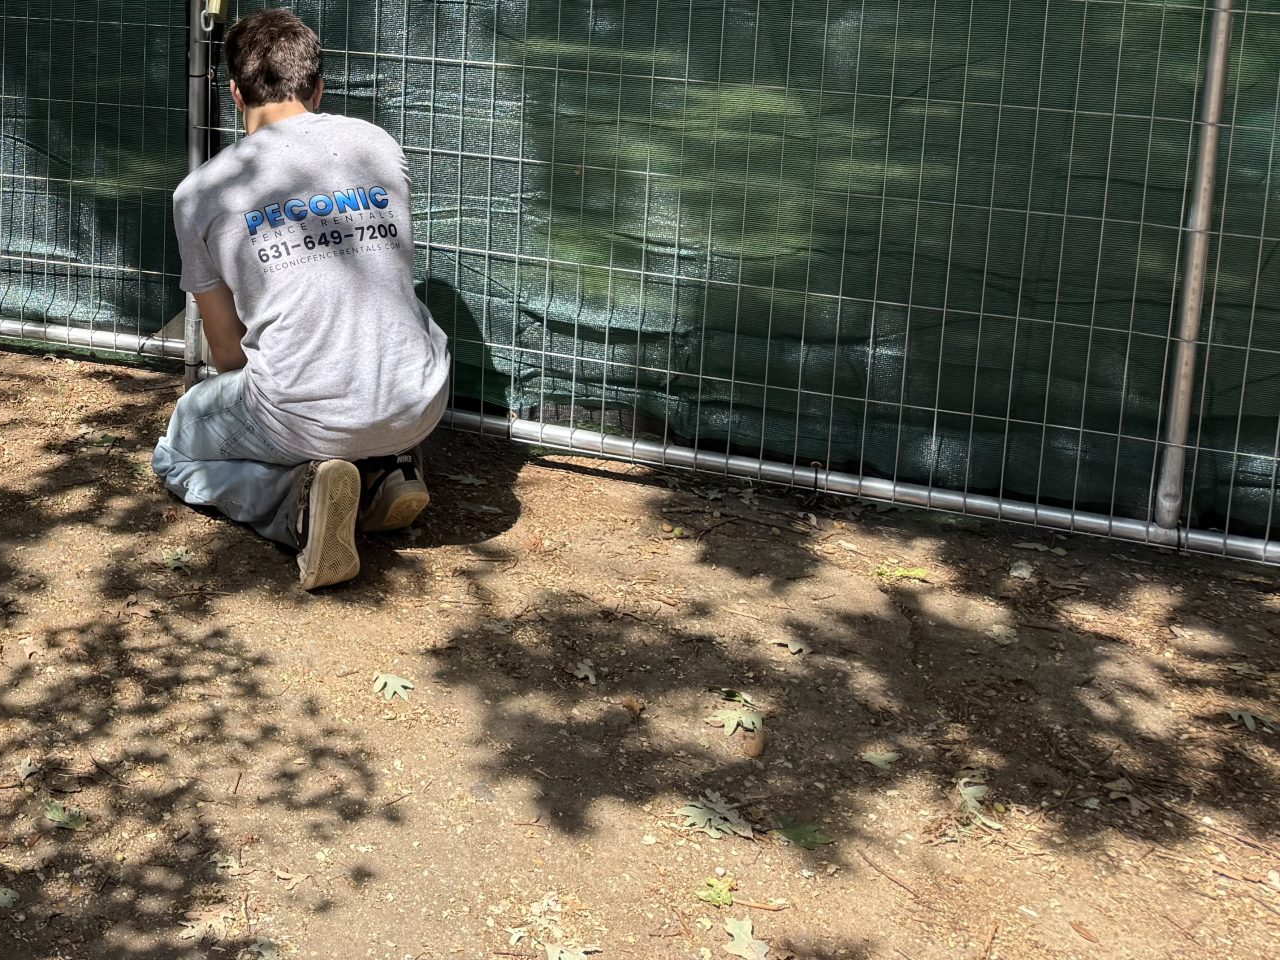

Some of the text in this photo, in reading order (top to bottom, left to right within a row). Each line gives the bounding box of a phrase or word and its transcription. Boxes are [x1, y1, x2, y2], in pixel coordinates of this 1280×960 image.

[244, 186, 389, 236] PECONIC
[252, 210, 395, 245] FENCE RENTALS
[258, 223, 397, 264] 631-649-7200
[396, 455, 412, 463] NIKE
